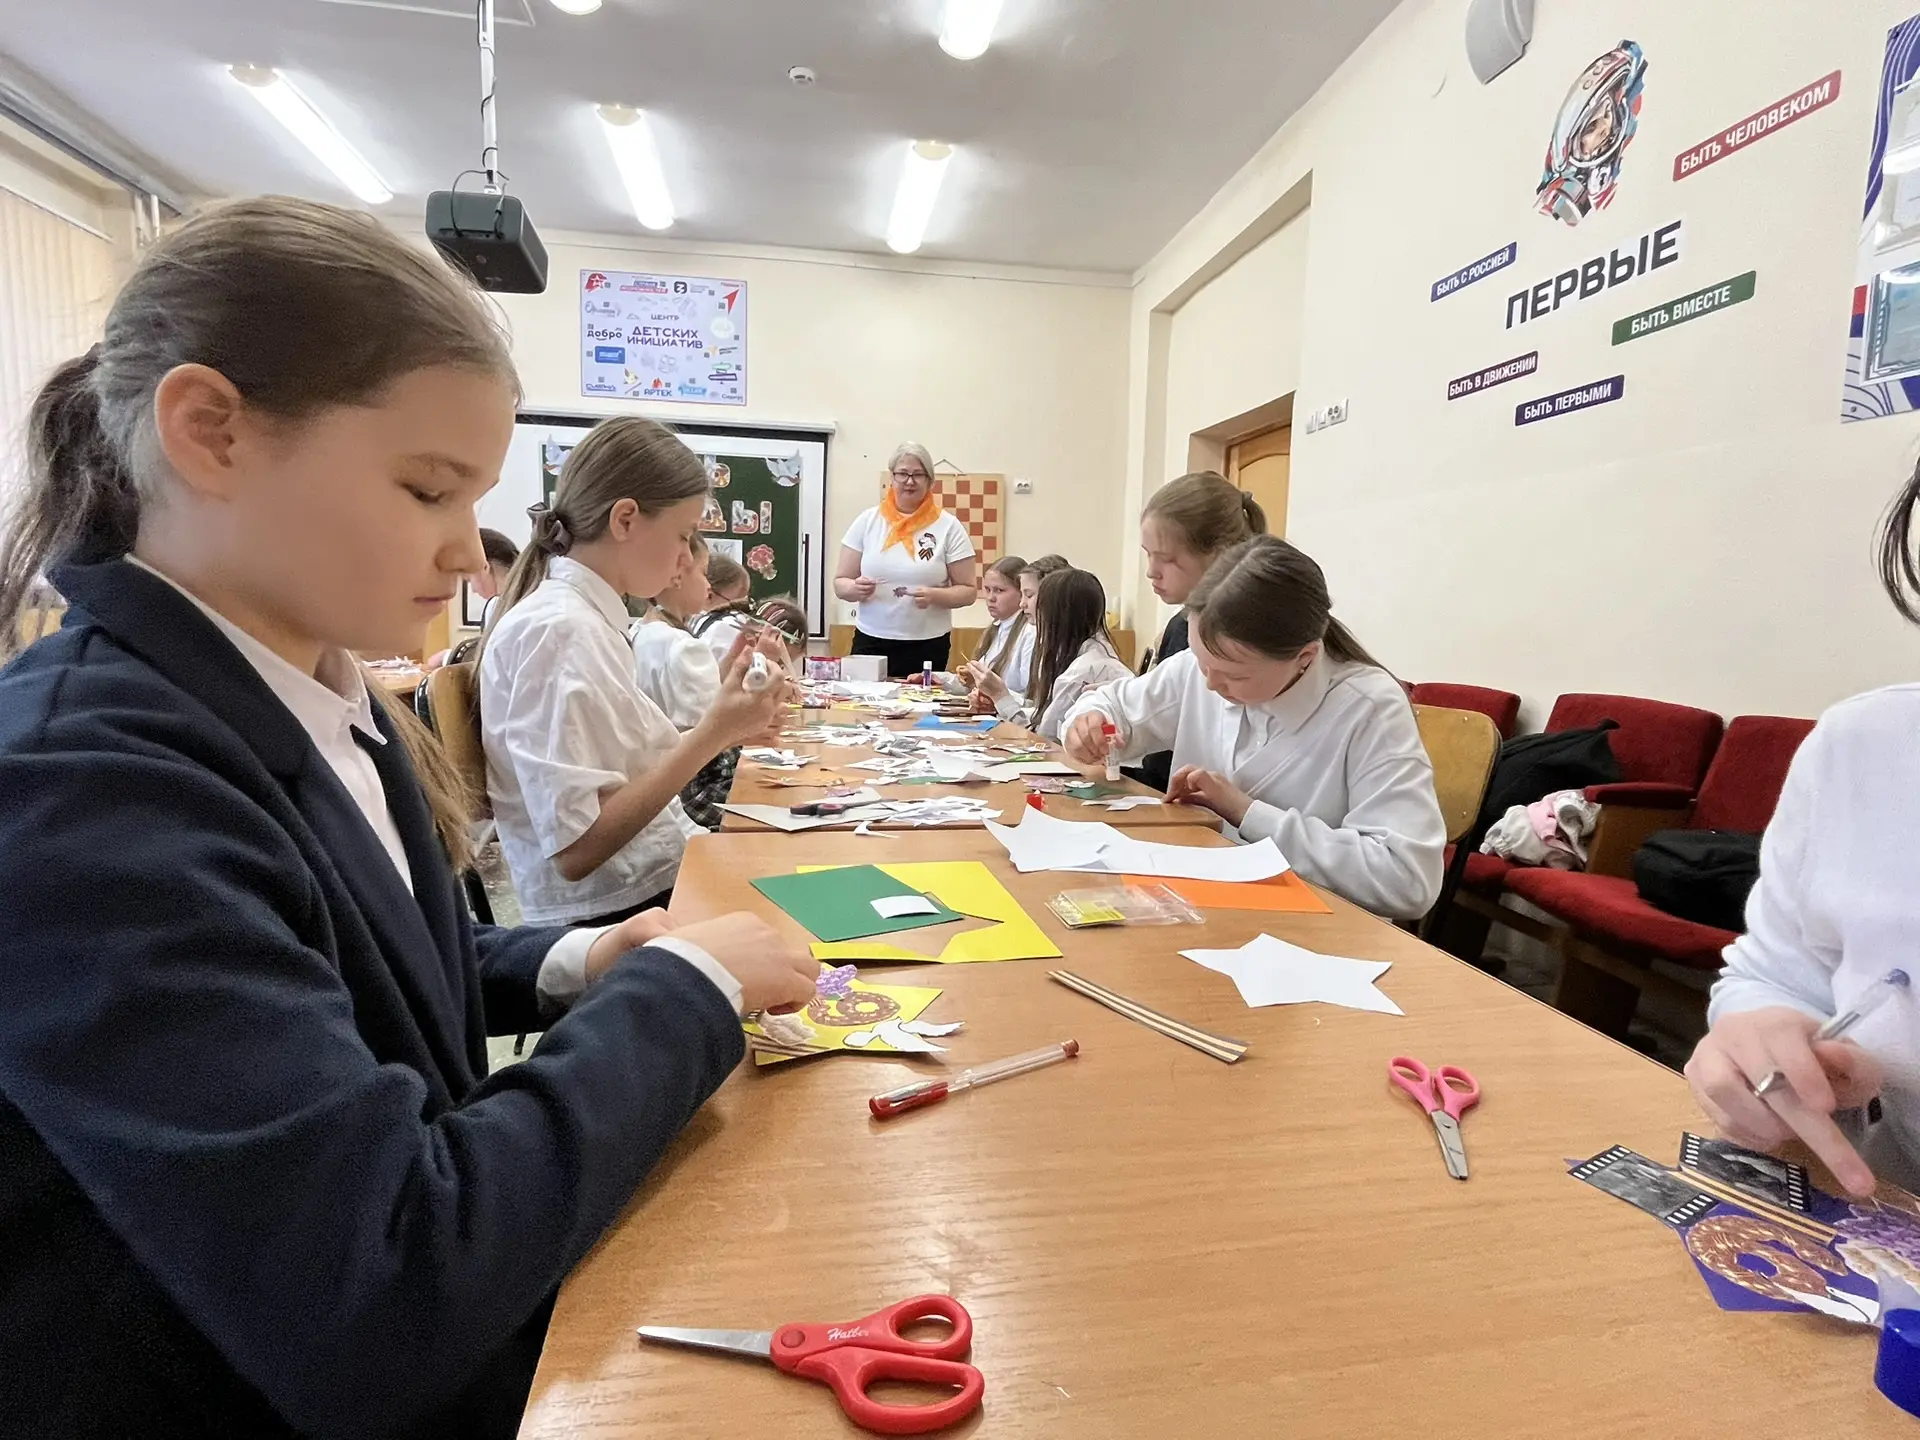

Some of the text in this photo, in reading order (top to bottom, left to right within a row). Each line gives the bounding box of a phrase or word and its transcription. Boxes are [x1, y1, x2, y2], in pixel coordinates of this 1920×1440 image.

[1680, 80, 1831, 174] БЫТЬ ЧЕЛОВЕКОМ
[1436, 247, 1510, 297] БЫТЬ С РОССИЕЙ
[1506, 219, 1682, 330] ПЕРВЫЕ
[650, 313, 680, 321] ЦЕНТР
[1630, 285, 1732, 336] БЫТЬ ВМЕСТЕ
[586, 328, 622, 341] добро
[626, 335, 704, 350] ИНИЦИАТИВ
[632, 326, 699, 340] ДЕТСКИХ
[1449, 356, 1536, 397] БЫТЬ В ДВИЖЕНИИ
[1523, 382, 1612, 420] БЫТЬ ПЕРВЫМИ
